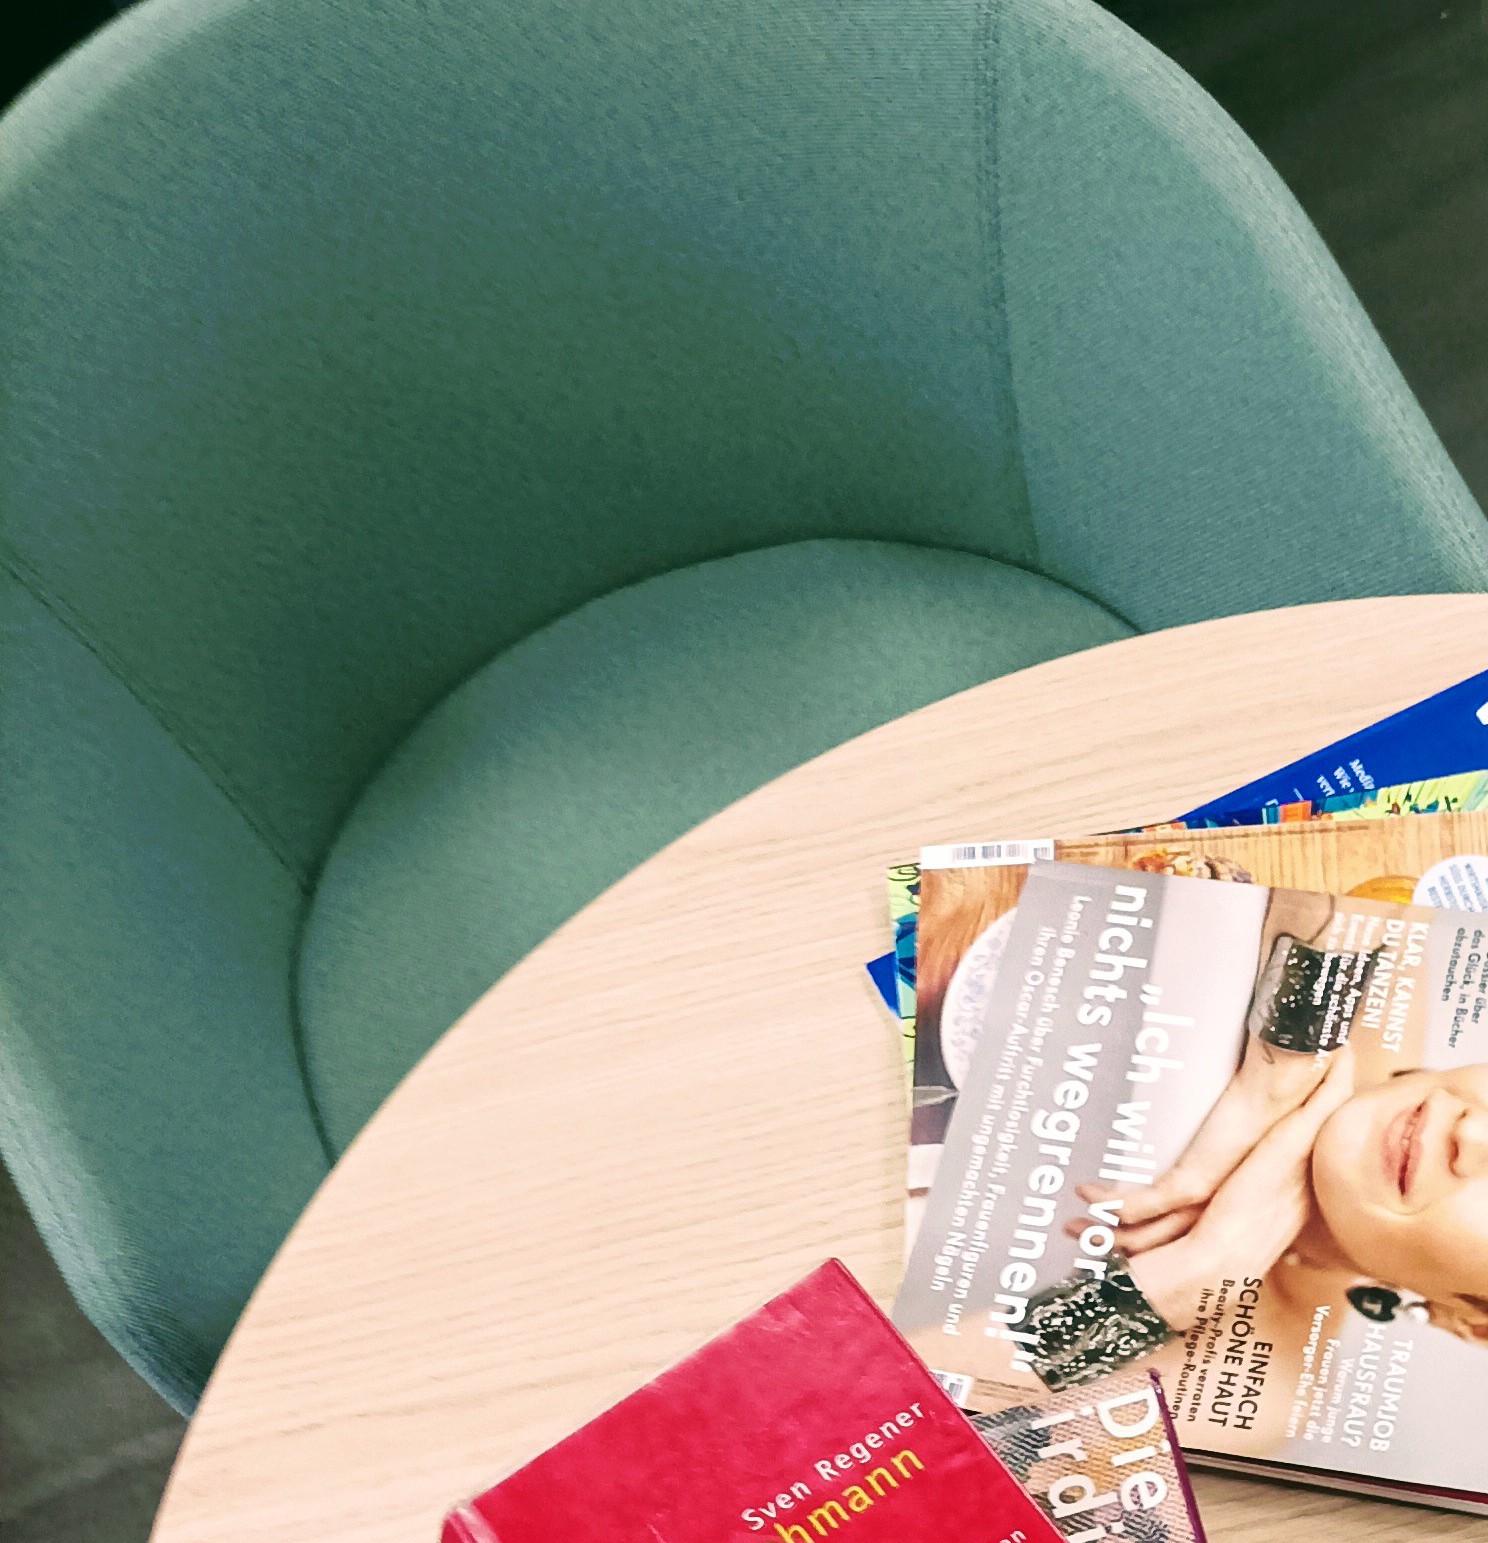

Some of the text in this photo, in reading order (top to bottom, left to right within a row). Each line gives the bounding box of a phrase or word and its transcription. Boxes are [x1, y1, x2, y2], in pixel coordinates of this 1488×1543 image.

[1078, 885, 1148, 1026] nichts
[1309, 952, 1336, 1006] bewegen
[1332, 969, 1349, 991] die
[1336, 952, 1354, 972] für
[1347, 949, 1372, 986] Ideen,
[1364, 918, 1403, 1028] DU TANZEN!
[1441, 926, 1467, 1001] abzutauchen
[1459, 952, 1481, 989] Glück,
[1470, 928, 1484, 949] das
[995, 970, 1044, 1079] Oscar-Auftritt
[1317, 993, 1344, 1047] schönste
[1337, 987, 1363, 1018] Apps
[1381, 922, 1430, 1052] KLAR, KANNST
[1448, 1007, 1468, 1048] Bücher
[1458, 993, 1468, 1004] in
[1471, 996, 1486, 1023] über
[1334, 1020, 1353, 1045] und
[940, 895, 1091, 1335] Leonie Benesch über Furchtlosigkeit, Frauenfiguren und
[985, 1083, 1004, 1110] mit
[951, 1114, 995, 1227] ungemachten
[1101, 1101, 1158, 1184] will
[930, 1230, 967, 1290] Nägeln
[1074, 1198, 1125, 1280] vor
[1169, 1288, 1213, 1420] ihre Pflege-Routinen
[1187, 1279, 1235, 1422] Beauty-Profis verraten
[1207, 1277, 1263, 1426] SCHÖNE HAUT
[1233, 1341, 1273, 1429] EINFACH
[1286, 1303, 1330, 1439] Versorger-Ehe feiern
[1303, 1337, 1343, 1440] Frauen jetzt die
[1339, 1322, 1386, 1447] HAUSFRAU?
[1319, 1357, 1355, 1443] Warum junge
[1366, 1339, 1413, 1453] TRAUMJOB
[741, 1402, 922, 1530] Sven Regener
[1095, 1388, 1170, 1511] Die
